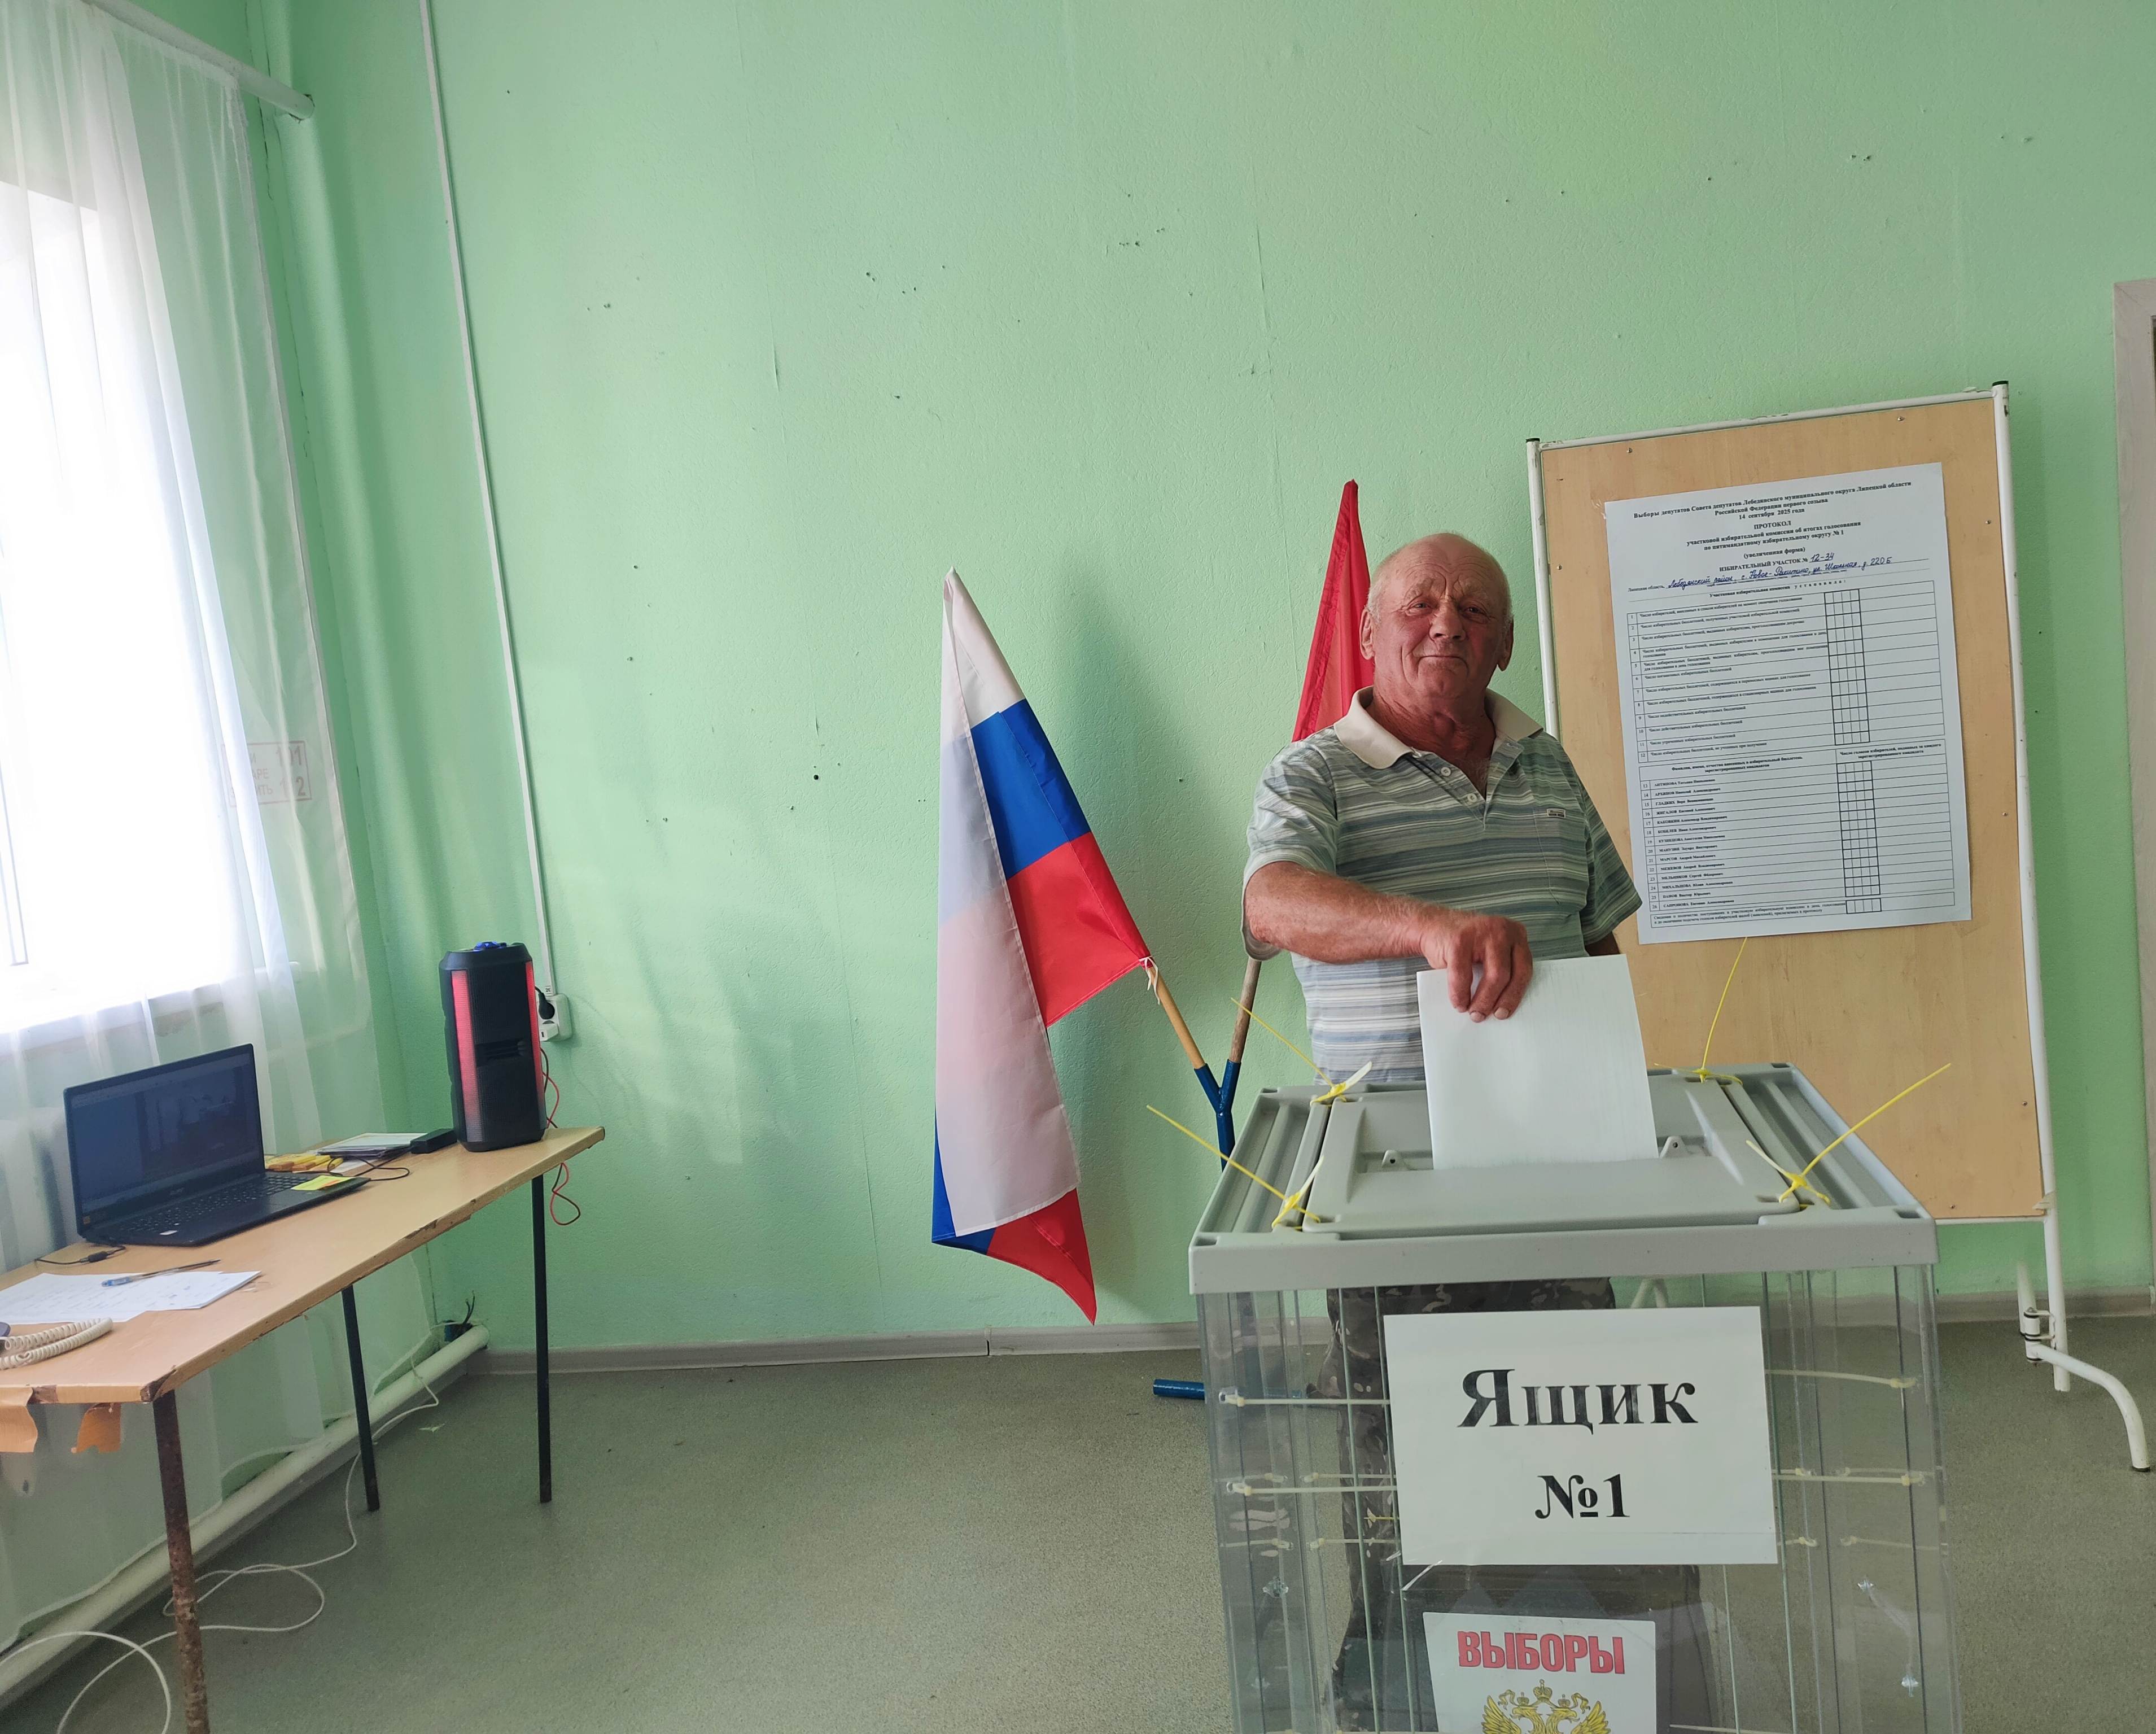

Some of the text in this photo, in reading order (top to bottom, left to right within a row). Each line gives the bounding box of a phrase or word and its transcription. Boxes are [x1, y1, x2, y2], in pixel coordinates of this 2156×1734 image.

[1660, 508, 1690, 516] депутатов
[1742, 496, 1783, 505] Лебедянского
[1784, 491, 1834, 501] муниципального
[1856, 483, 1887, 492] Липецкой
[1715, 506, 1748, 516] Российской
[1686, 536, 1720, 547] участковой
[1721, 531, 1764, 541] избирательной
[1823, 521, 1861, 530] голосования
[1753, 520, 1791, 530] ПРОТОКОЛ
[1712, 540, 1761, 549] пятимандатному
[1762, 534, 1810, 544] избирательному
[1743, 546, 1805, 559] (увеличенная форма)
[1719, 561, 1772, 572] ИЗБИРАТЕЛЬНЫЙ
[1810, 552, 1834, 562] 12-34
[1457, 1369, 1699, 1435] Ящик
[1534, 1474, 1630, 1520] №1
[1457, 1631, 1625, 1675] ВЫБОРЫ
